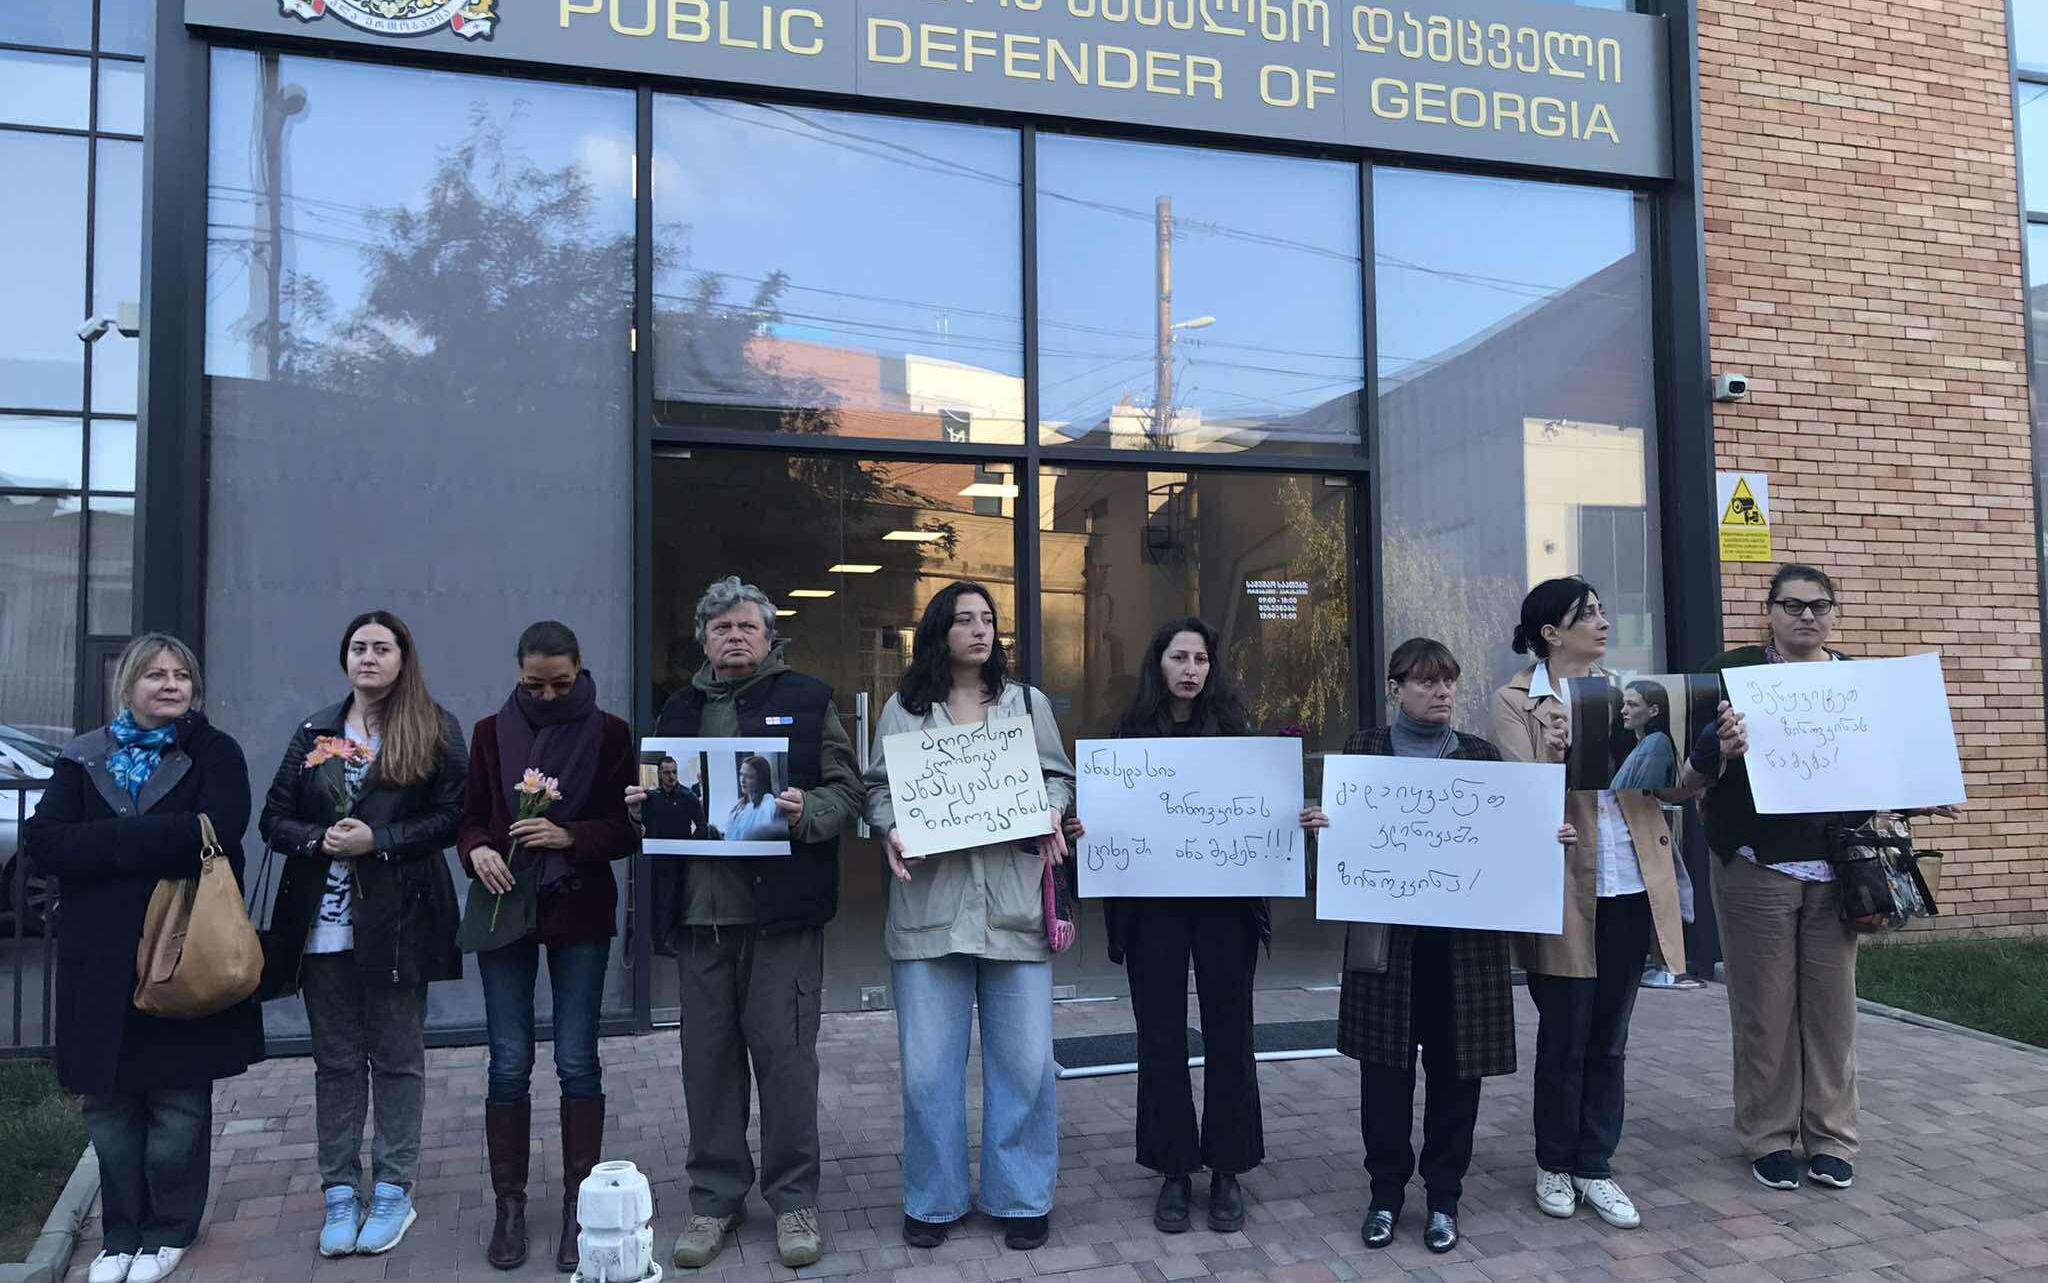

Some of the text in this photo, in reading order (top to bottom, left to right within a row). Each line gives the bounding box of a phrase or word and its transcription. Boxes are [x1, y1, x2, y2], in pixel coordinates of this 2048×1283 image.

[1352, 4, 1621, 83] დამცველი
[559, 0, 1621, 144] PUBLIC DEFENDER OF GEORGIA
[901, 768, 1029, 804] ანასტასია
[1083, 748, 1176, 789] ანასტასია
[909, 789, 1049, 832] ზინოვკინას
[1159, 791, 1271, 825] ზინოვკინას
